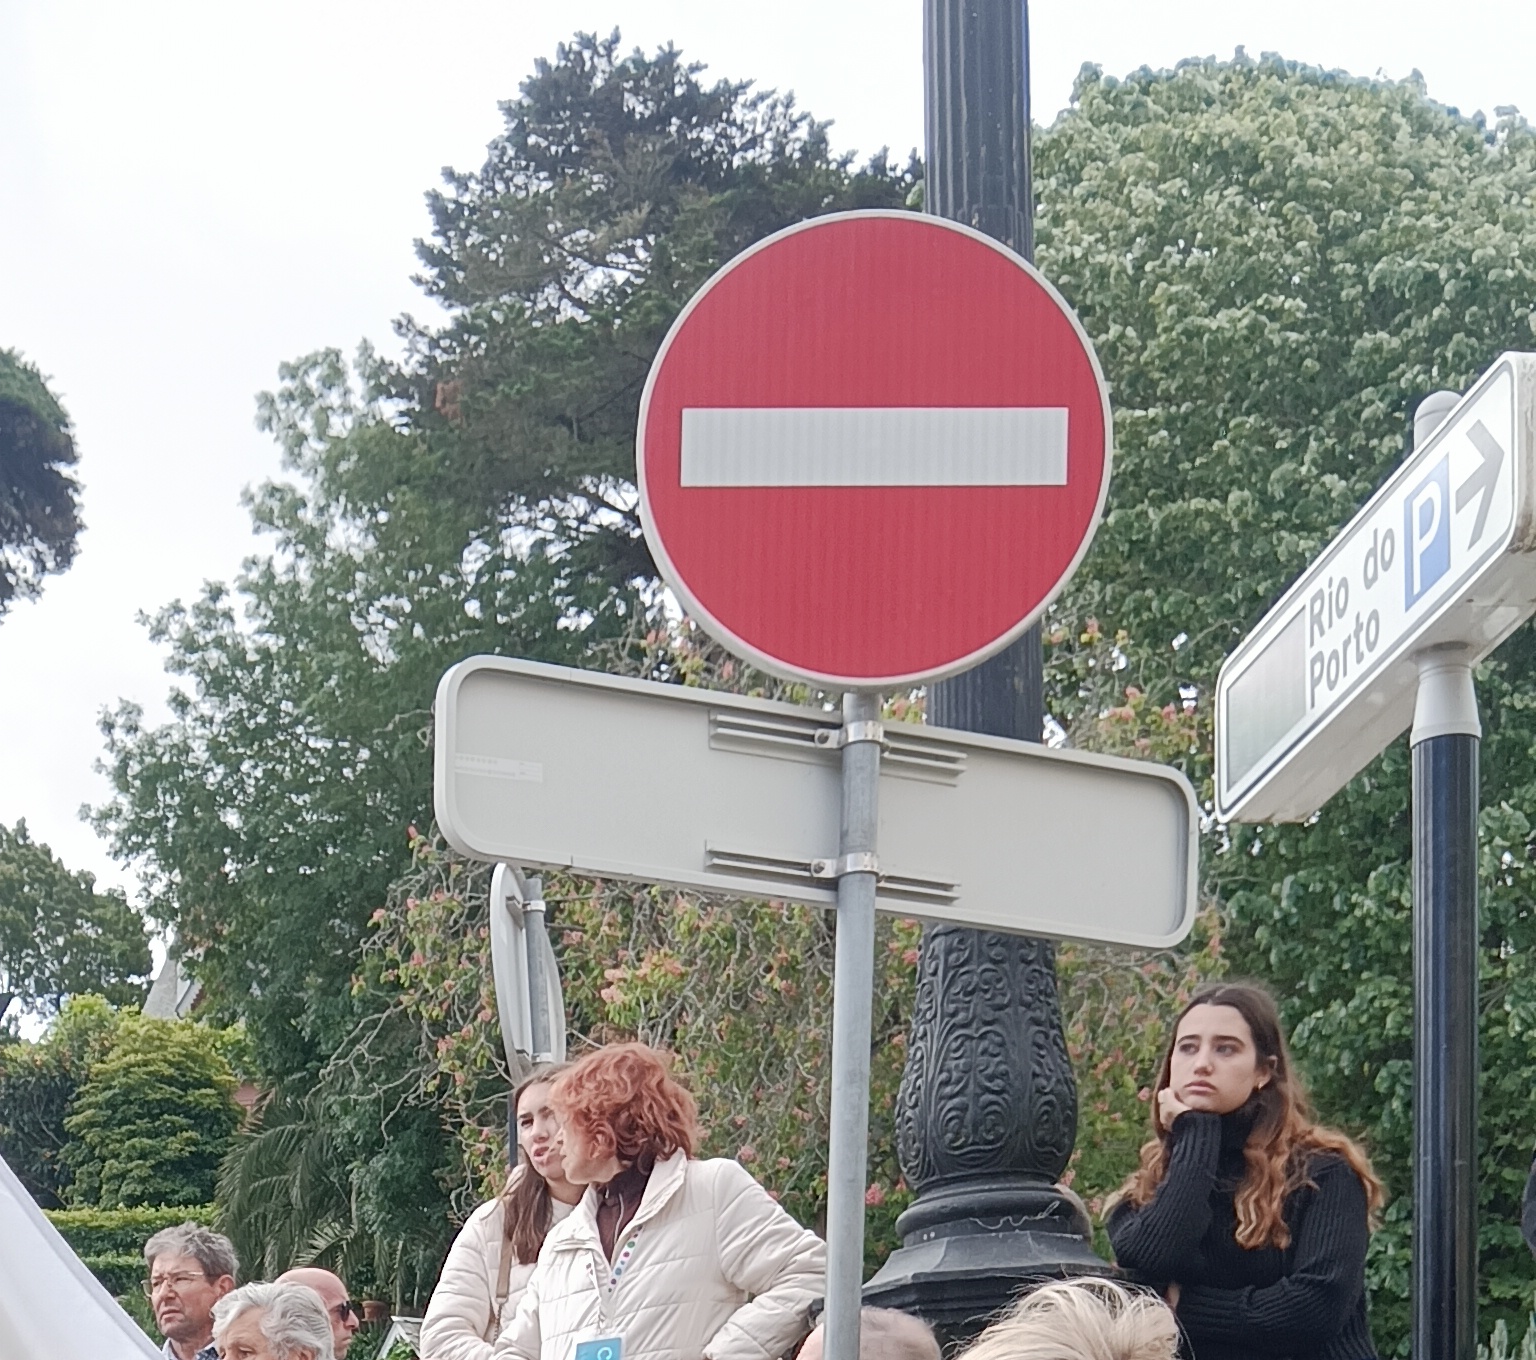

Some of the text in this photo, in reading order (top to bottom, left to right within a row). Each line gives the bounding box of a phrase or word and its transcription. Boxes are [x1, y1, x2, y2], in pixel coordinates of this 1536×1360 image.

[1308, 527, 1396, 649] Rio do
[1309, 608, 1381, 710] Porto
